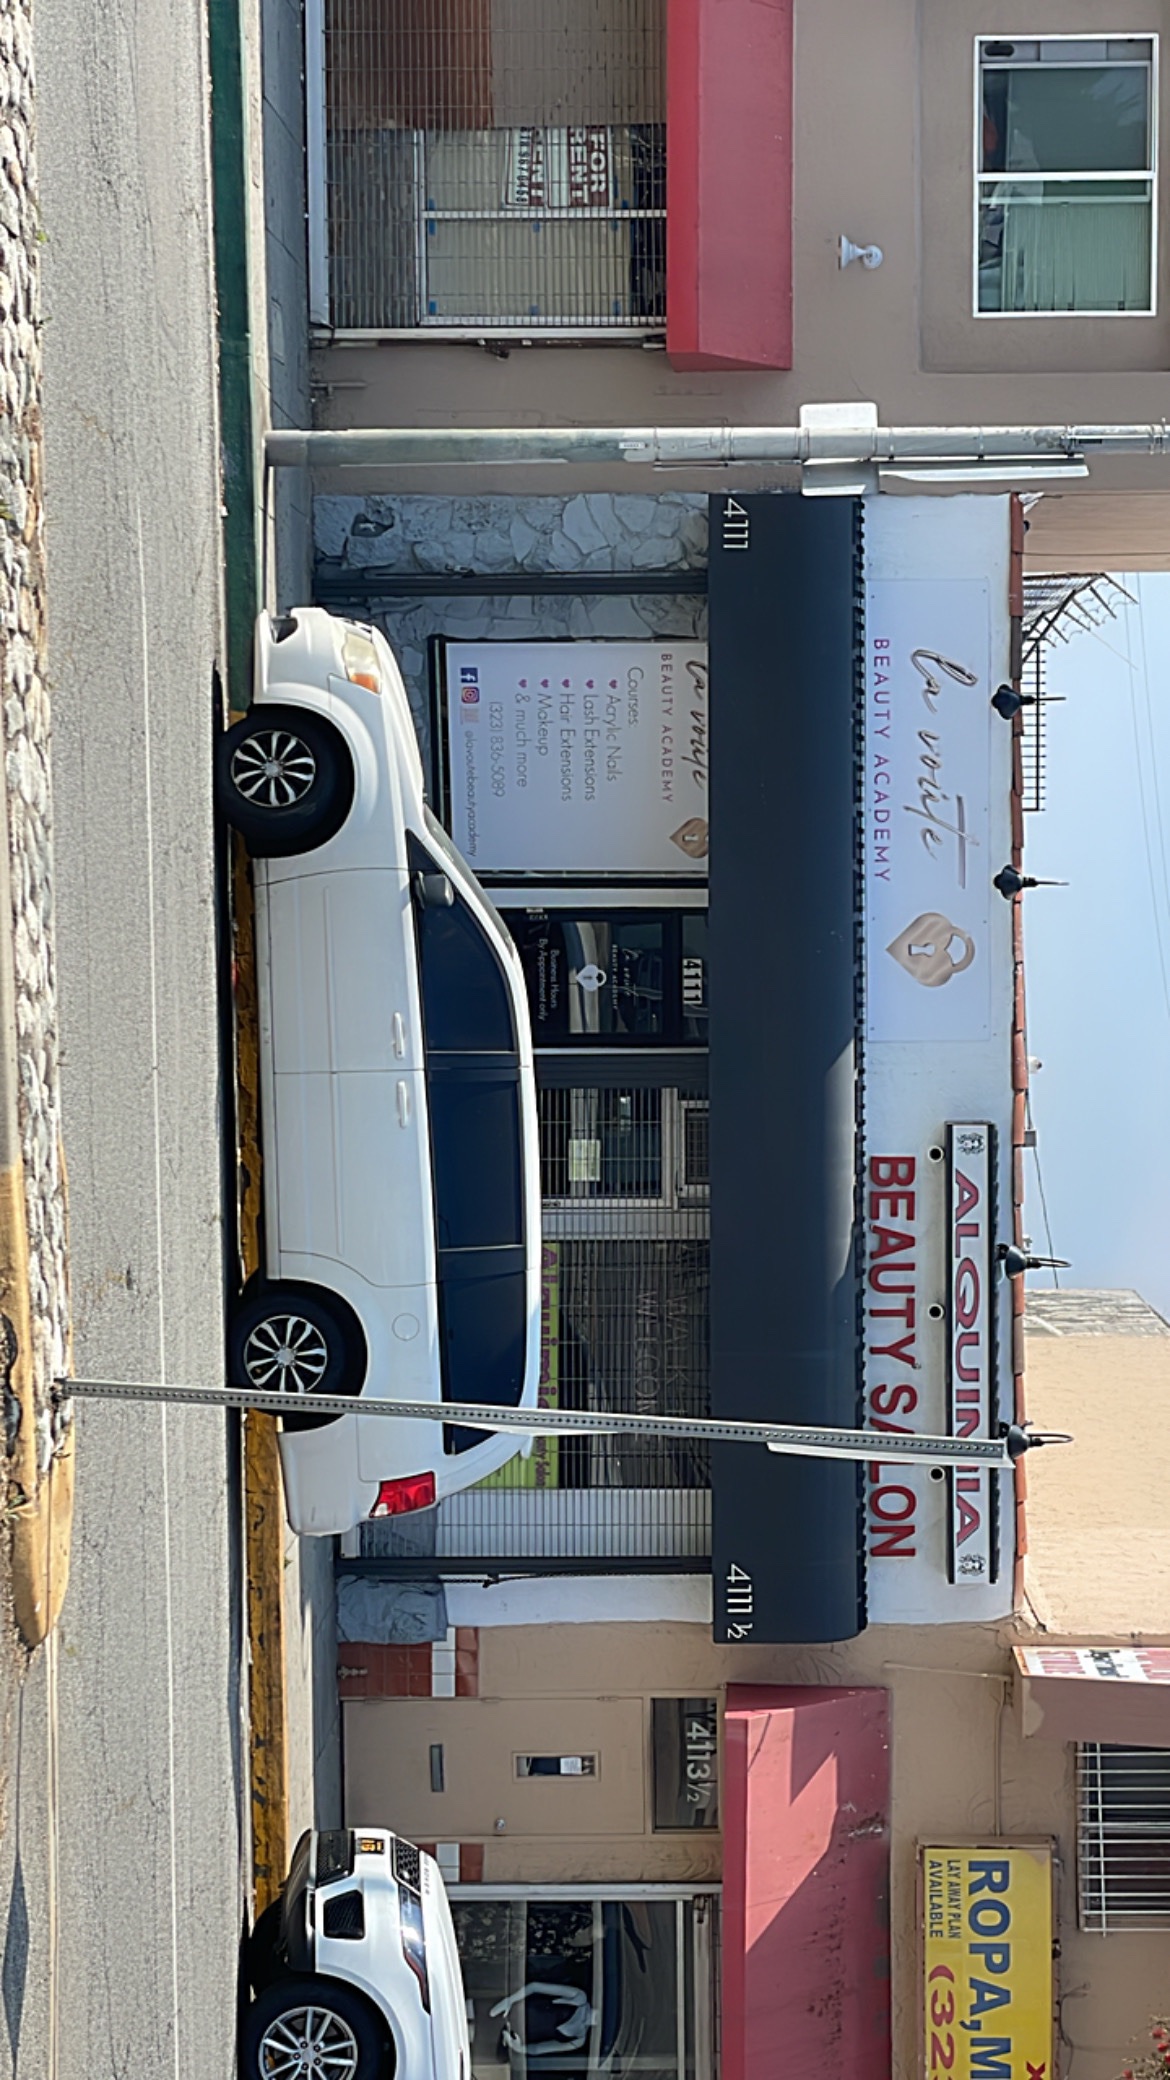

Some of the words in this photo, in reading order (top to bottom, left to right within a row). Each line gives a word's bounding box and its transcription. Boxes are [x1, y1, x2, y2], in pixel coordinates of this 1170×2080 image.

[570, 127, 588, 204] RENT
[590, 133, 606, 193] FOR
[723, 498, 749, 549] 4111
[515, 693, 530, 704] &
[559, 693, 574, 723] Hair
[627, 666, 644, 728] Courses:
[661, 653, 673, 716] BEAUTY
[872, 638, 890, 740] BEAUTY
[488, 702, 504, 732] (323)
[516, 710, 531, 748] much
[534, 693, 553, 756] Makeup
[582, 695, 600, 726] Lash
[602, 694, 621, 741] Acrylic
[489, 736, 505, 798] 836-5089
[516, 752, 529, 788] more
[559, 729, 575, 802] Extensions
[583, 729, 600, 802] Extensions
[606, 746, 621, 782] Nails
[661, 725, 674, 803] ACADEMY
[872, 754, 890, 882] ACADEMY
[537, 938, 548, 948] By
[549, 949, 560, 982] Business
[537, 950, 548, 1002] Appointment
[550, 984, 560, 1008] Hours
[682, 960, 702, 1004] 4111
[537, 1004, 548, 1022] only
[870, 1156, 916, 1367] BEAUTY
[634, 1290, 660, 1442] WELCOM
[955, 1169, 981, 1548] ALQUIMIA
[726, 1563, 752, 1614] 4111
[947, 1859, 960, 1879] LAY
[929, 1860, 943, 1938] AVAILABLE
[947, 1882, 961, 1910] AWAY
[947, 1913, 961, 1938] PLAN
[928, 1964, 954, 2080] (32
